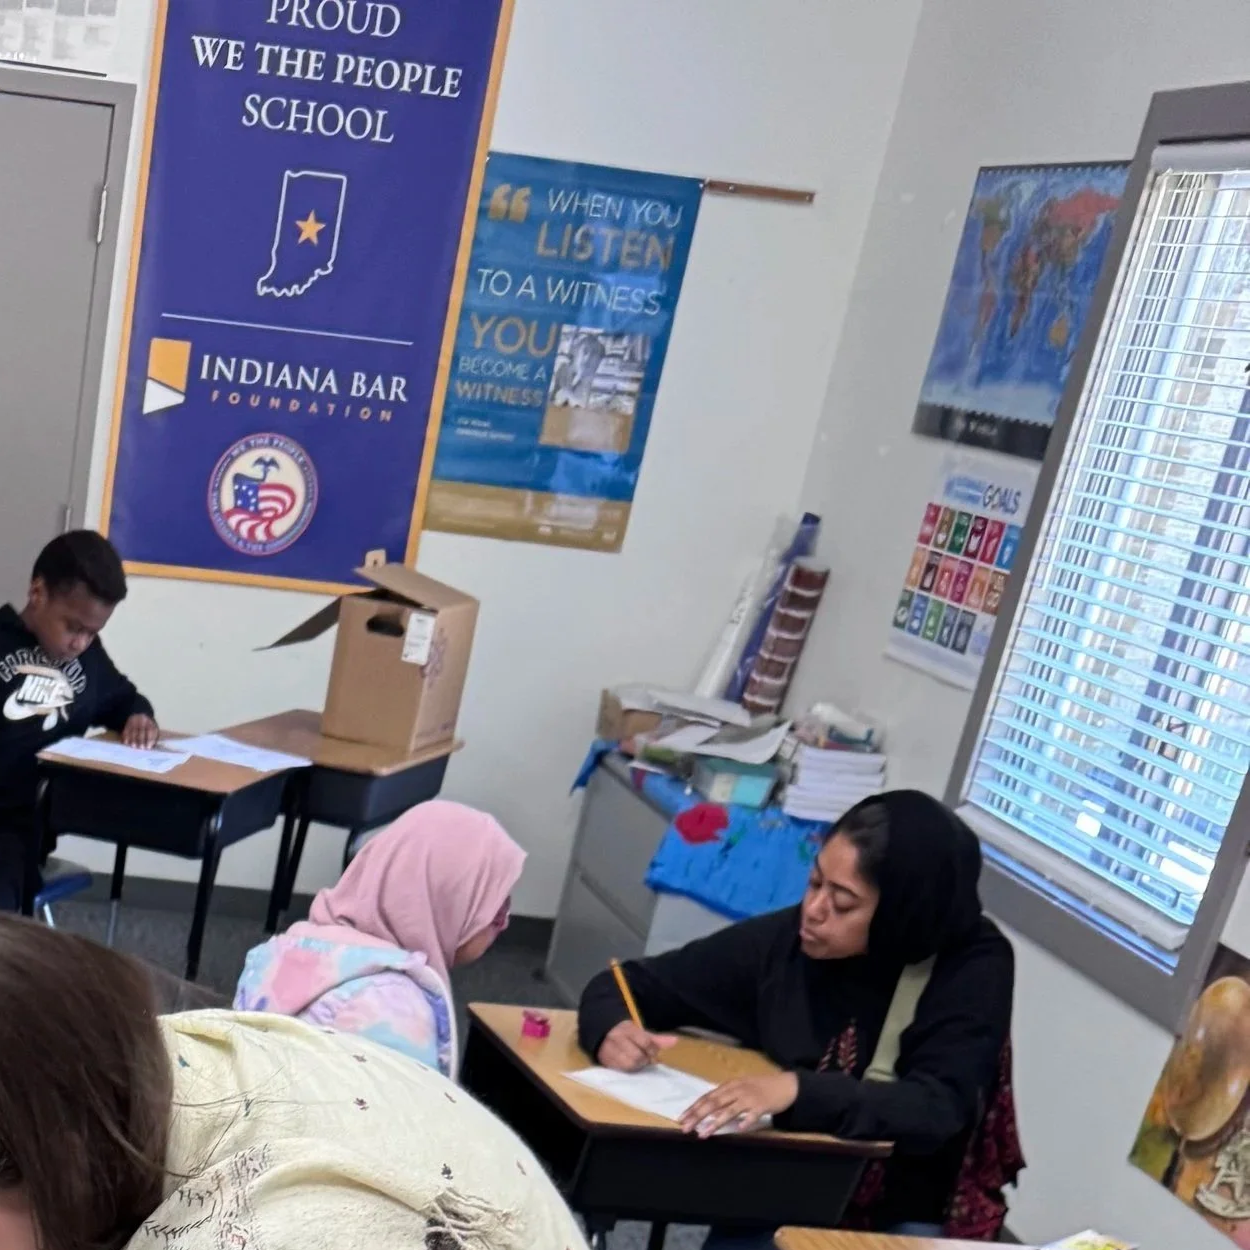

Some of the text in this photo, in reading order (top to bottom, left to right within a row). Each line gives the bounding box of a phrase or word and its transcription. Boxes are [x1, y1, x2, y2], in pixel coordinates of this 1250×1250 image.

[266, 0, 401, 37] PROUD
[191, 35, 463, 98] WE THE PEOPLE
[241, 93, 394, 144] SCHOOL
[548, 188, 682, 229] WHEN YOU
[536, 223, 673, 268] LISTEN
[477, 268, 662, 316] TO A WITNESS
[470, 314, 558, 357] YOU
[200, 354, 408, 403] INDIANA BAR
[458, 355, 547, 383] BECOME A
[211, 390, 393, 422] FOUNDATION
[454, 380, 543, 408] WITNESS
